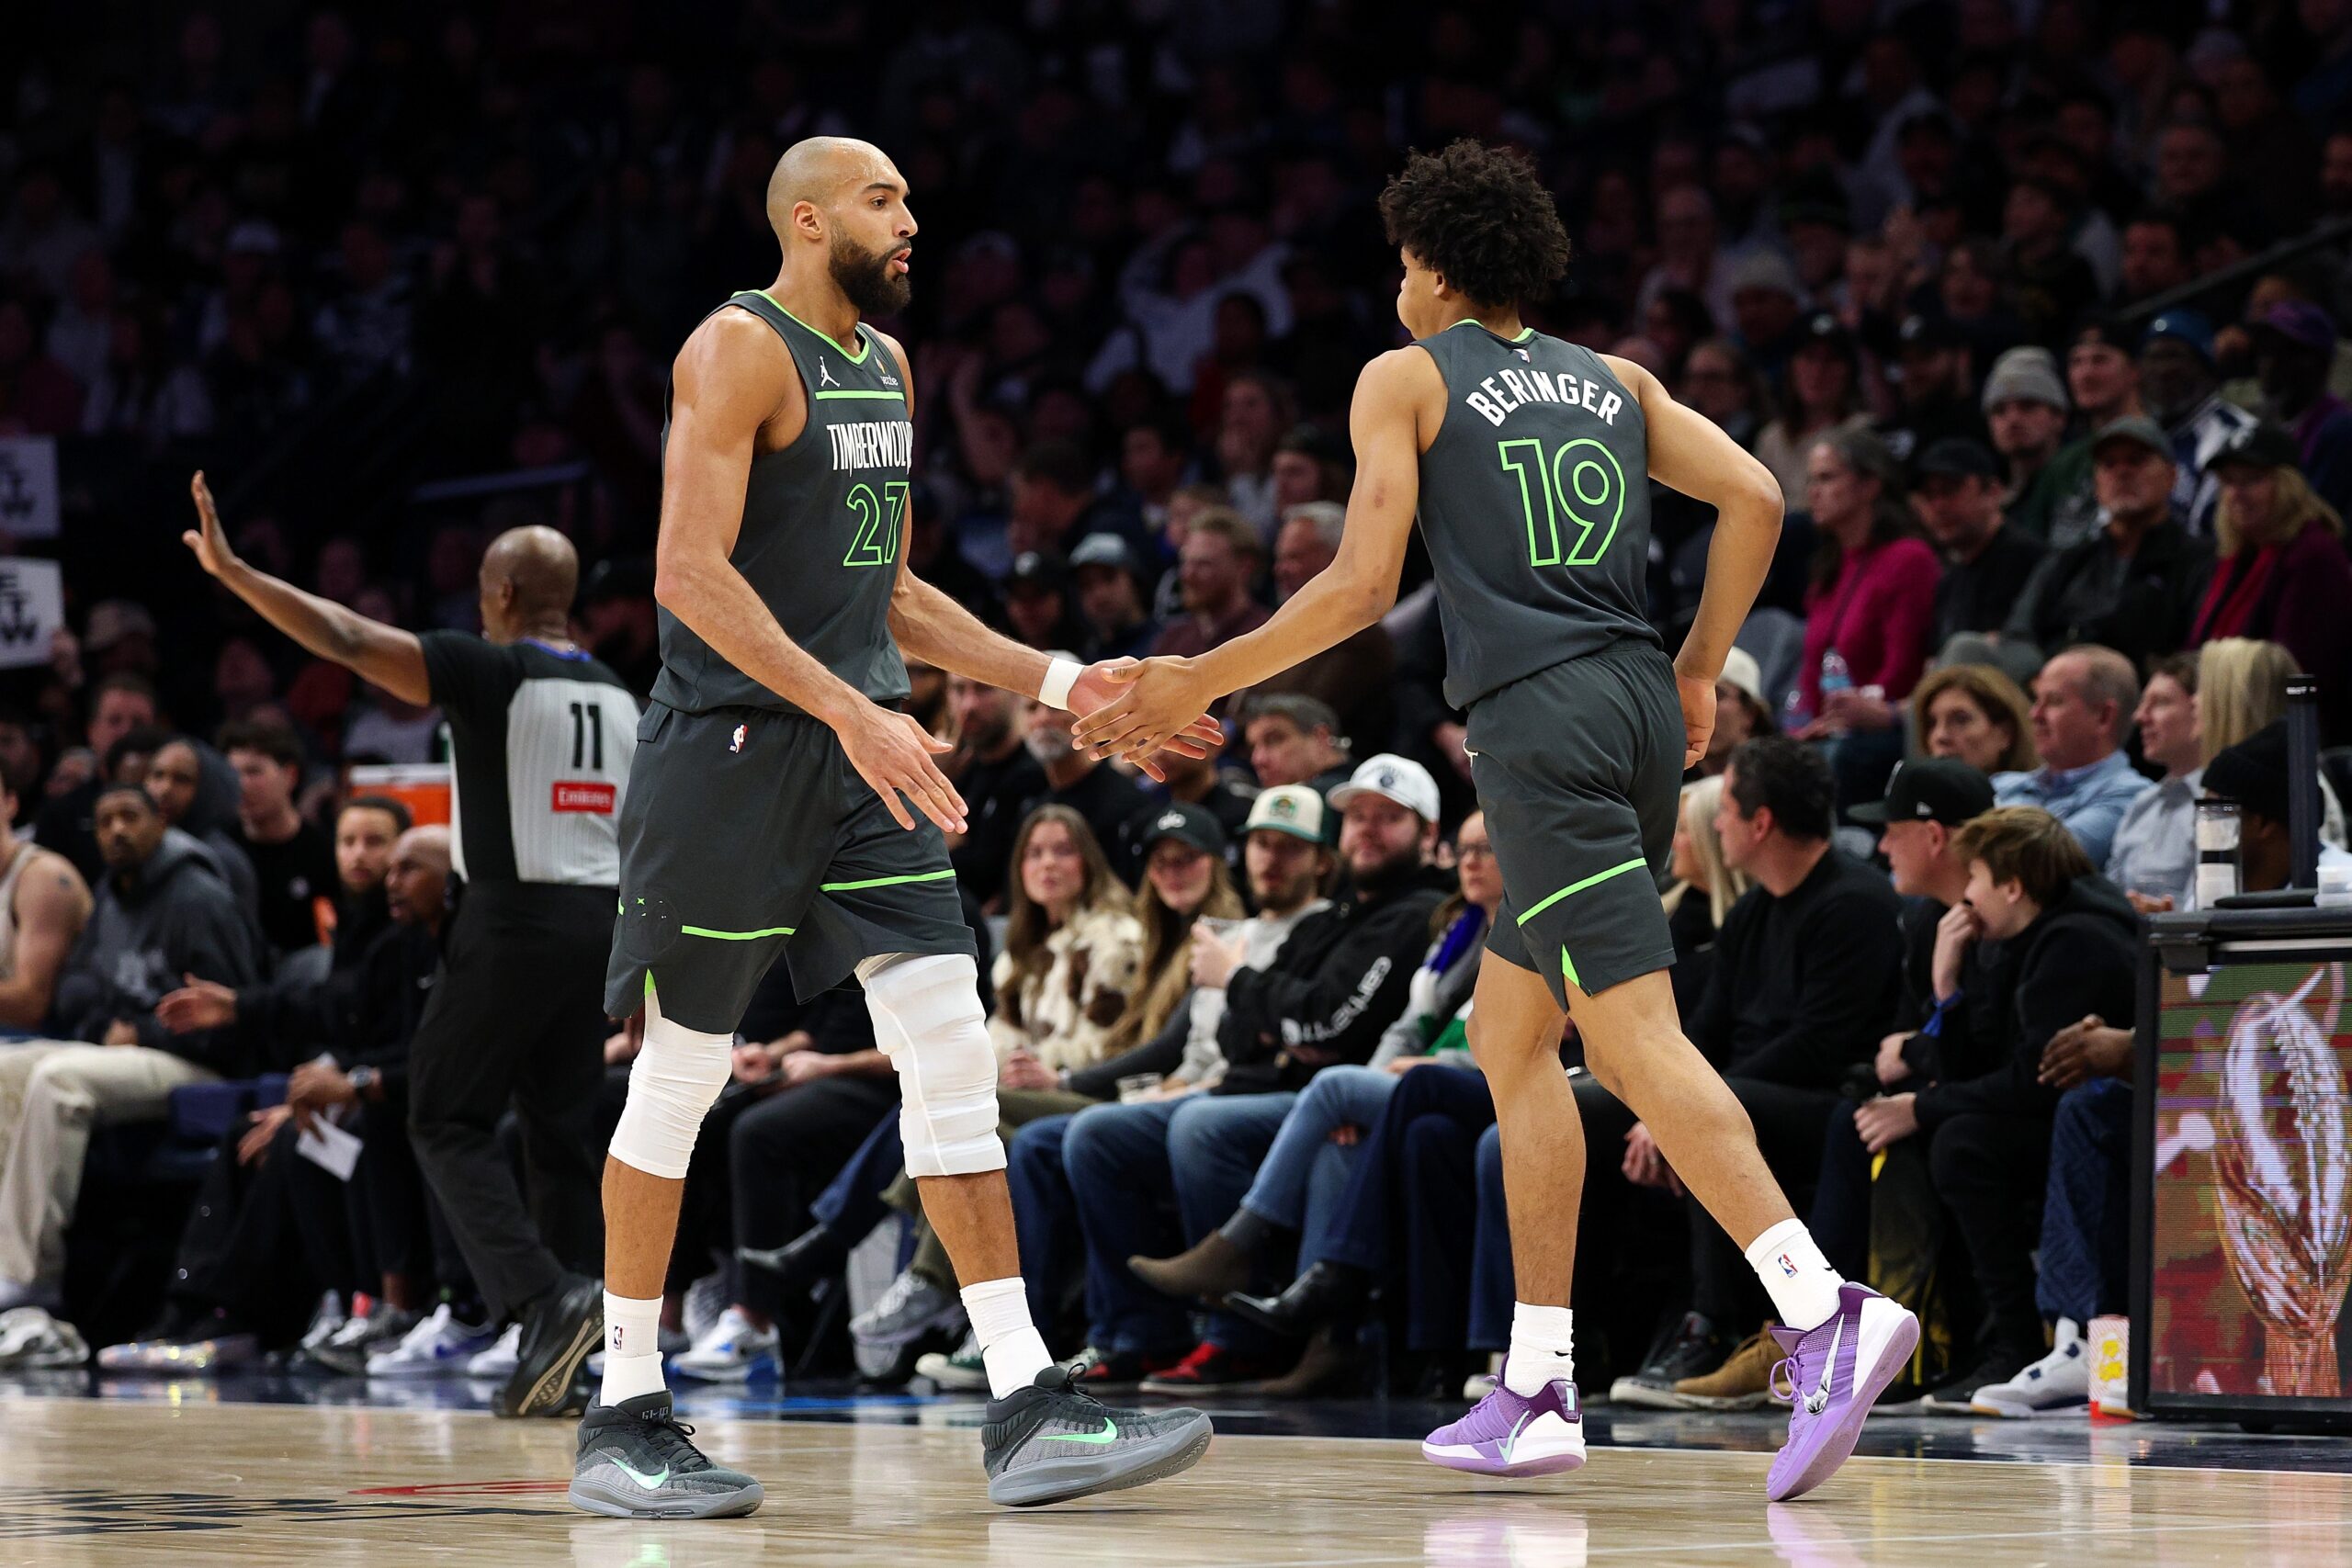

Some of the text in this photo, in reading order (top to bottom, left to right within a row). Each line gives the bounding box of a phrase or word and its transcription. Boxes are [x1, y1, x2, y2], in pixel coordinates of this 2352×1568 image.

[1465, 368, 1623, 427] BERINGER
[842, 481, 910, 567] 27
[1498, 438, 1625, 567] 19
[571, 702, 603, 770] 11
